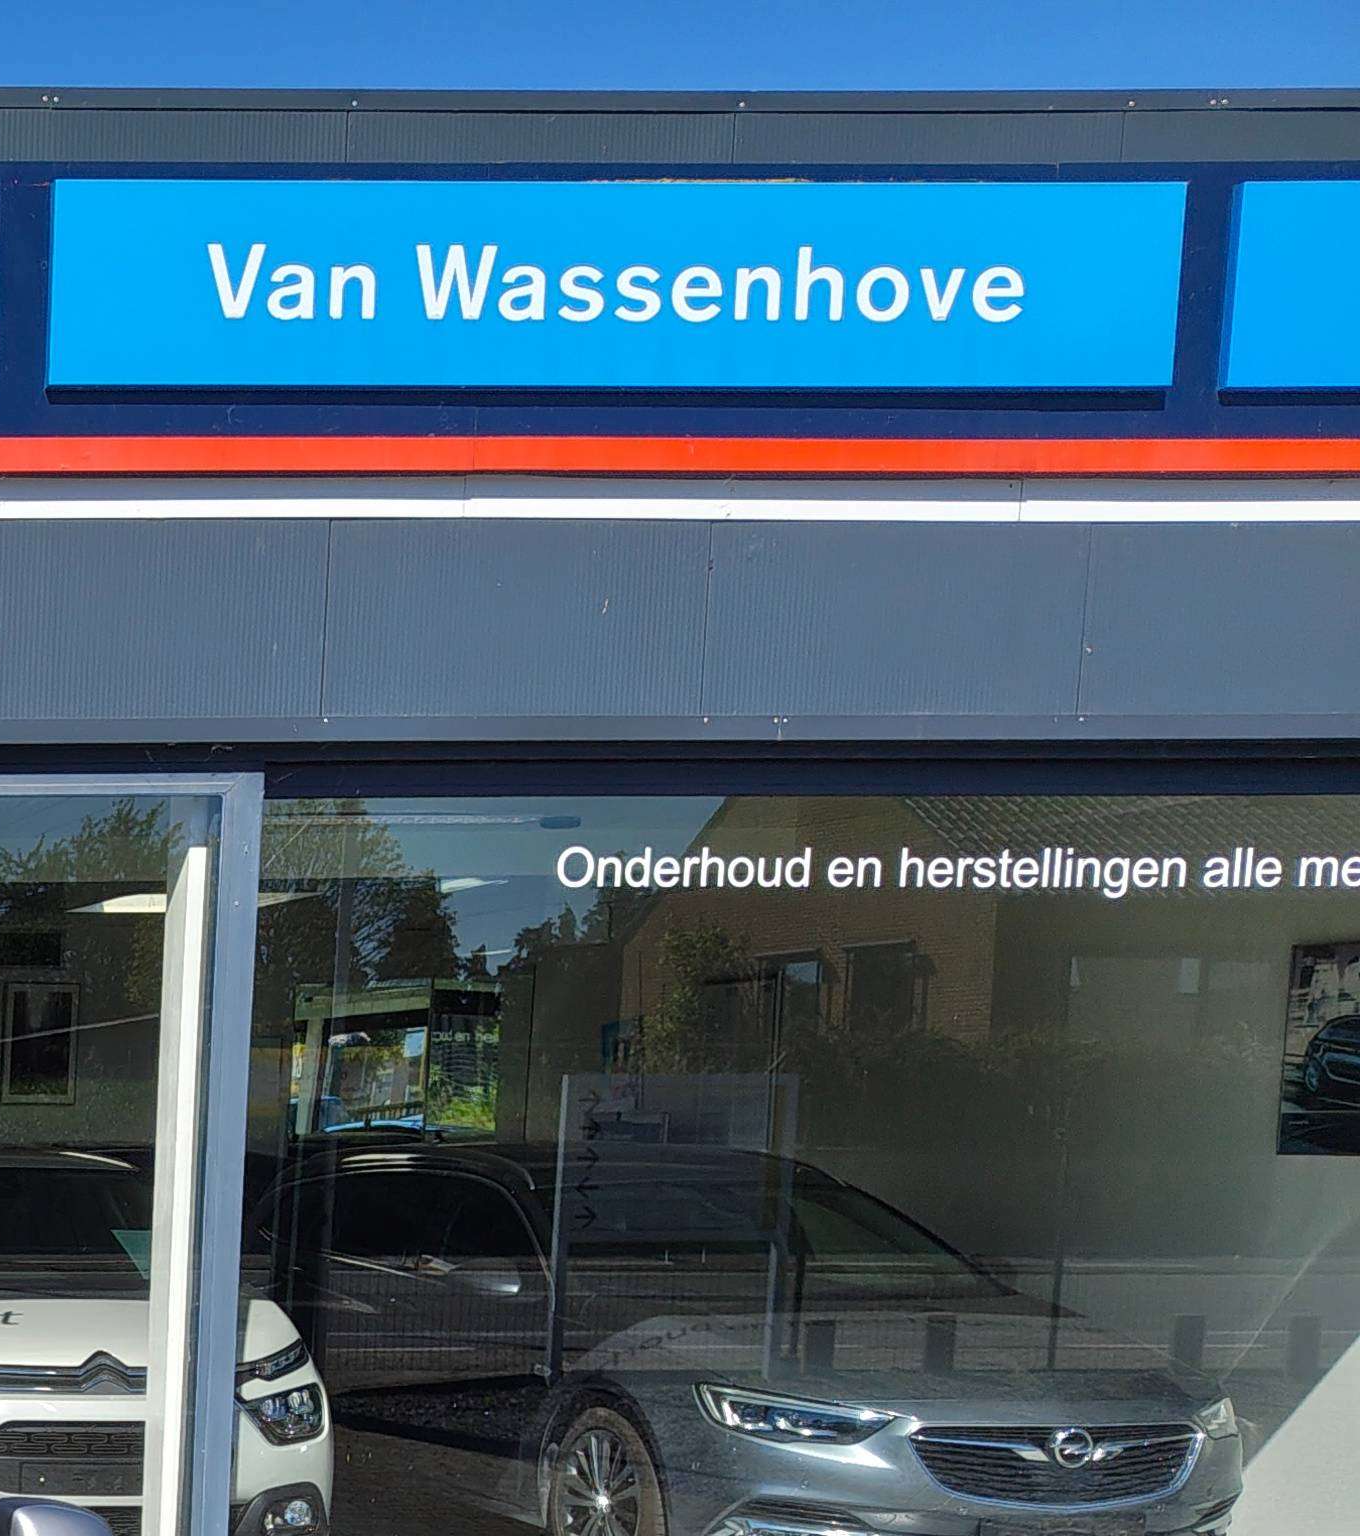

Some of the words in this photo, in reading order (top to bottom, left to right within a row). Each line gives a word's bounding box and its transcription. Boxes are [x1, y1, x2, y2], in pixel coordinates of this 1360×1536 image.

[207, 243, 376, 321] Van
[416, 244, 1025, 323] Wassenhove
[556, 845, 813, 889] Onderhoud
[826, 856, 883, 889] en
[898, 846, 1188, 900] herstellingen
[1202, 846, 1283, 889] alle
[1298, 855, 1360, 889] me
